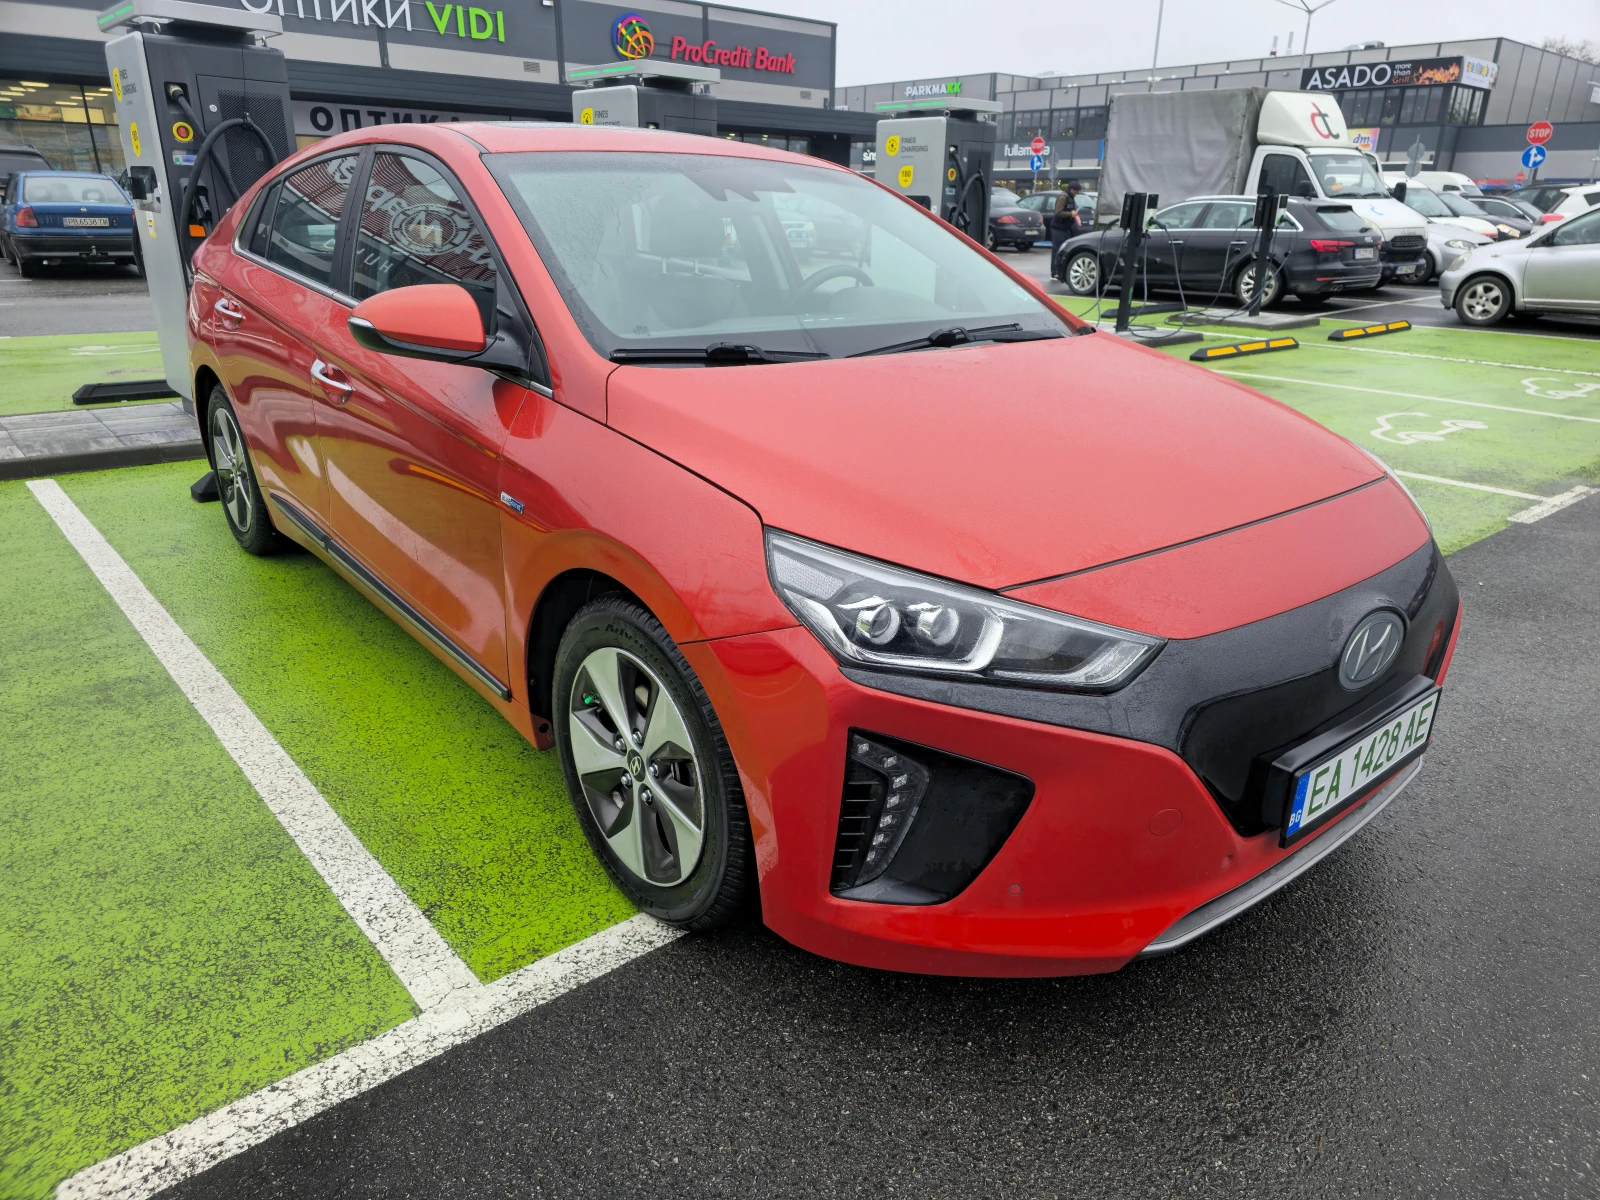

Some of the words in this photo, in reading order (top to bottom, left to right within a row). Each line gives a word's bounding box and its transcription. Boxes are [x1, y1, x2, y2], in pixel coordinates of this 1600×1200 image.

[425, 1, 505, 42] VIDI
[670, 35, 752, 68] ProCredit
[754, 46, 796, 73] Bank
[1306, 64, 1392, 90] ASADO
[1392, 76, 1410, 84] Grill
[310, 106, 460, 132] ОПТ
[594, 110, 609, 118] FINES
[1353, 133, 1370, 144] dm
[1529, 128, 1551, 138] STOP
[901, 145, 928, 153] CHARGING
[1004, 144, 1050, 156] fullama
[1307, 758, 1342, 817] EA
[1350, 720, 1402, 789] 1428
[1400, 700, 1433, 753] AE
[1288, 809, 1302, 828] BG
